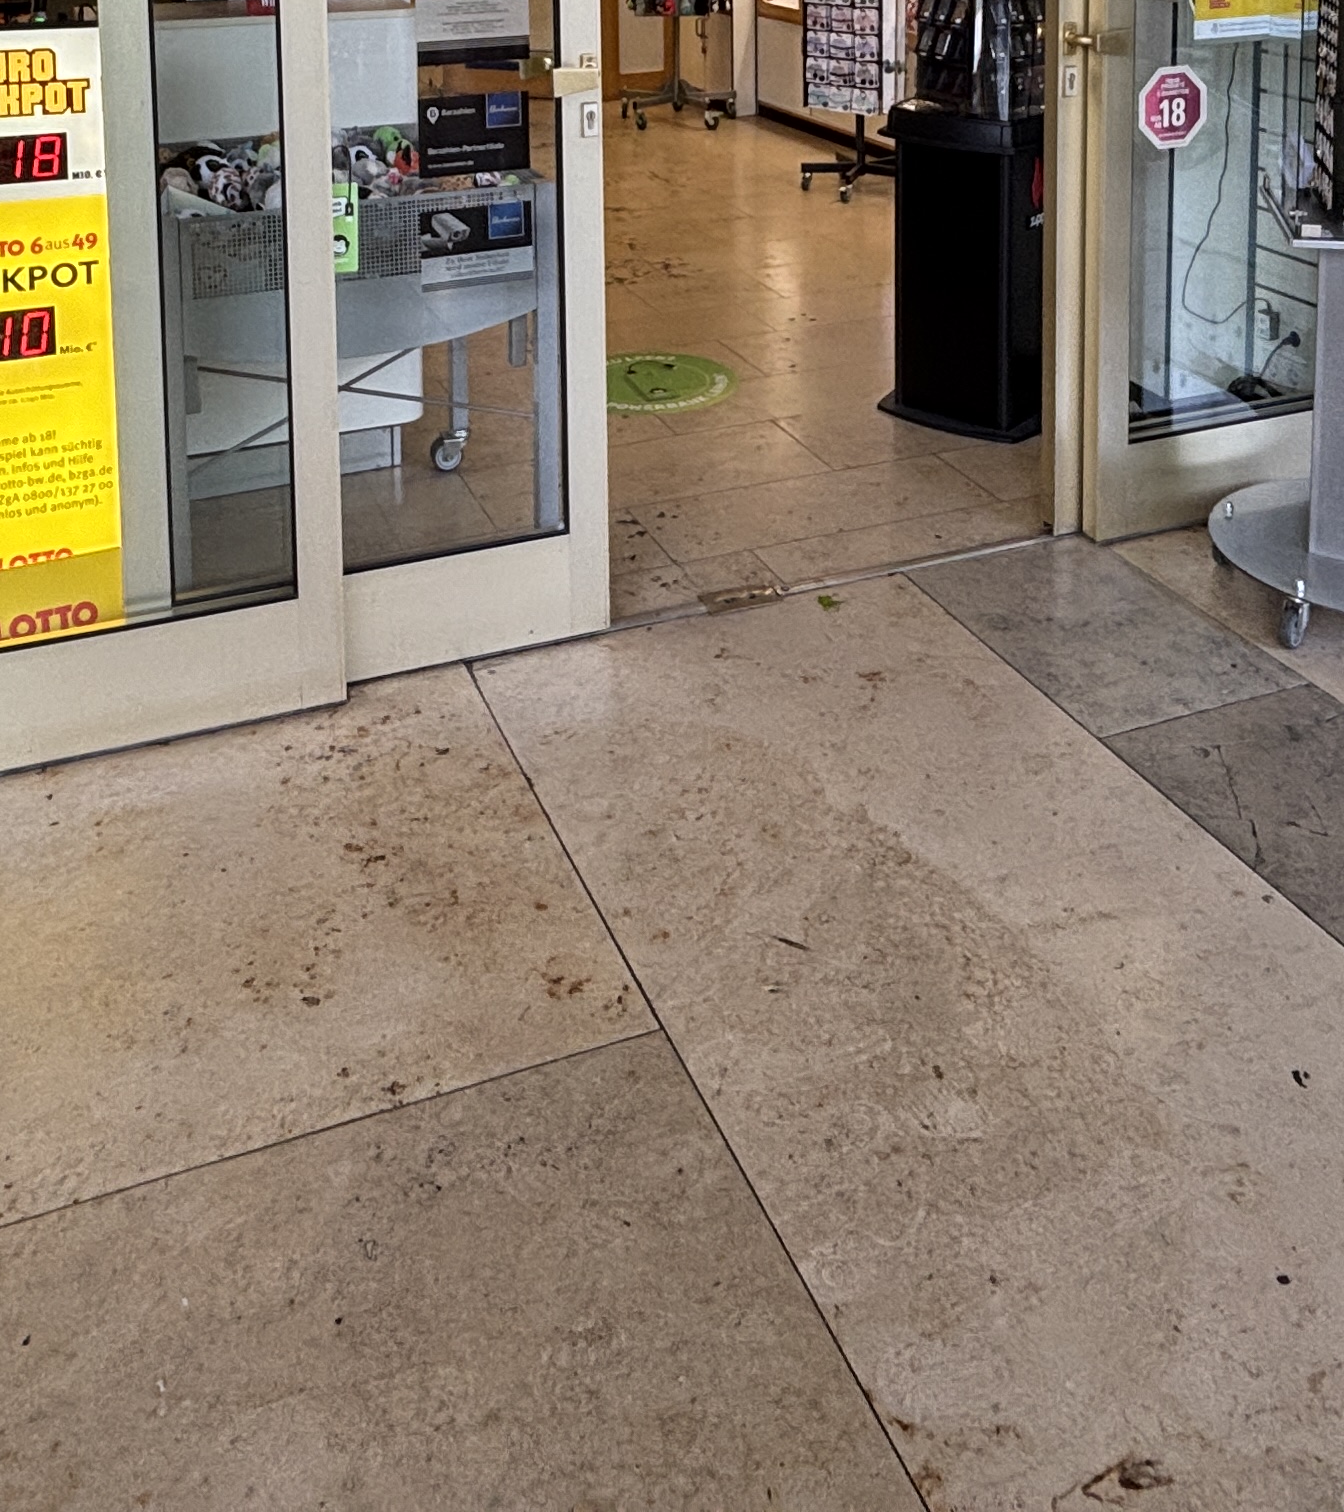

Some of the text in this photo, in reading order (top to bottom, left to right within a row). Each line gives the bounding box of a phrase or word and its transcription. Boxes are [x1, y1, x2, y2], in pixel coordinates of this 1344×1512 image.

[1159, 97, 1186, 128] 18
[13, 134, 62, 179] 18
[0, 309, 51, 357] 10
[59, 344, 84, 355] Mio.
[22, 432, 37, 445] ab
[40, 429, 57, 442] 18!
[30, 444, 58, 457] kann
[61, 437, 104, 452] süchtig
[11, 460, 41, 475] Infos
[43, 456, 65, 470] und
[68, 452, 94, 466] Hilfe
[68, 464, 114, 482] bzga.de
[82, 481, 97, 494] 27
[98, 479, 114, 490] 00
[25, 502, 48, 517] und
[50, 494, 104, 514] anonym).
